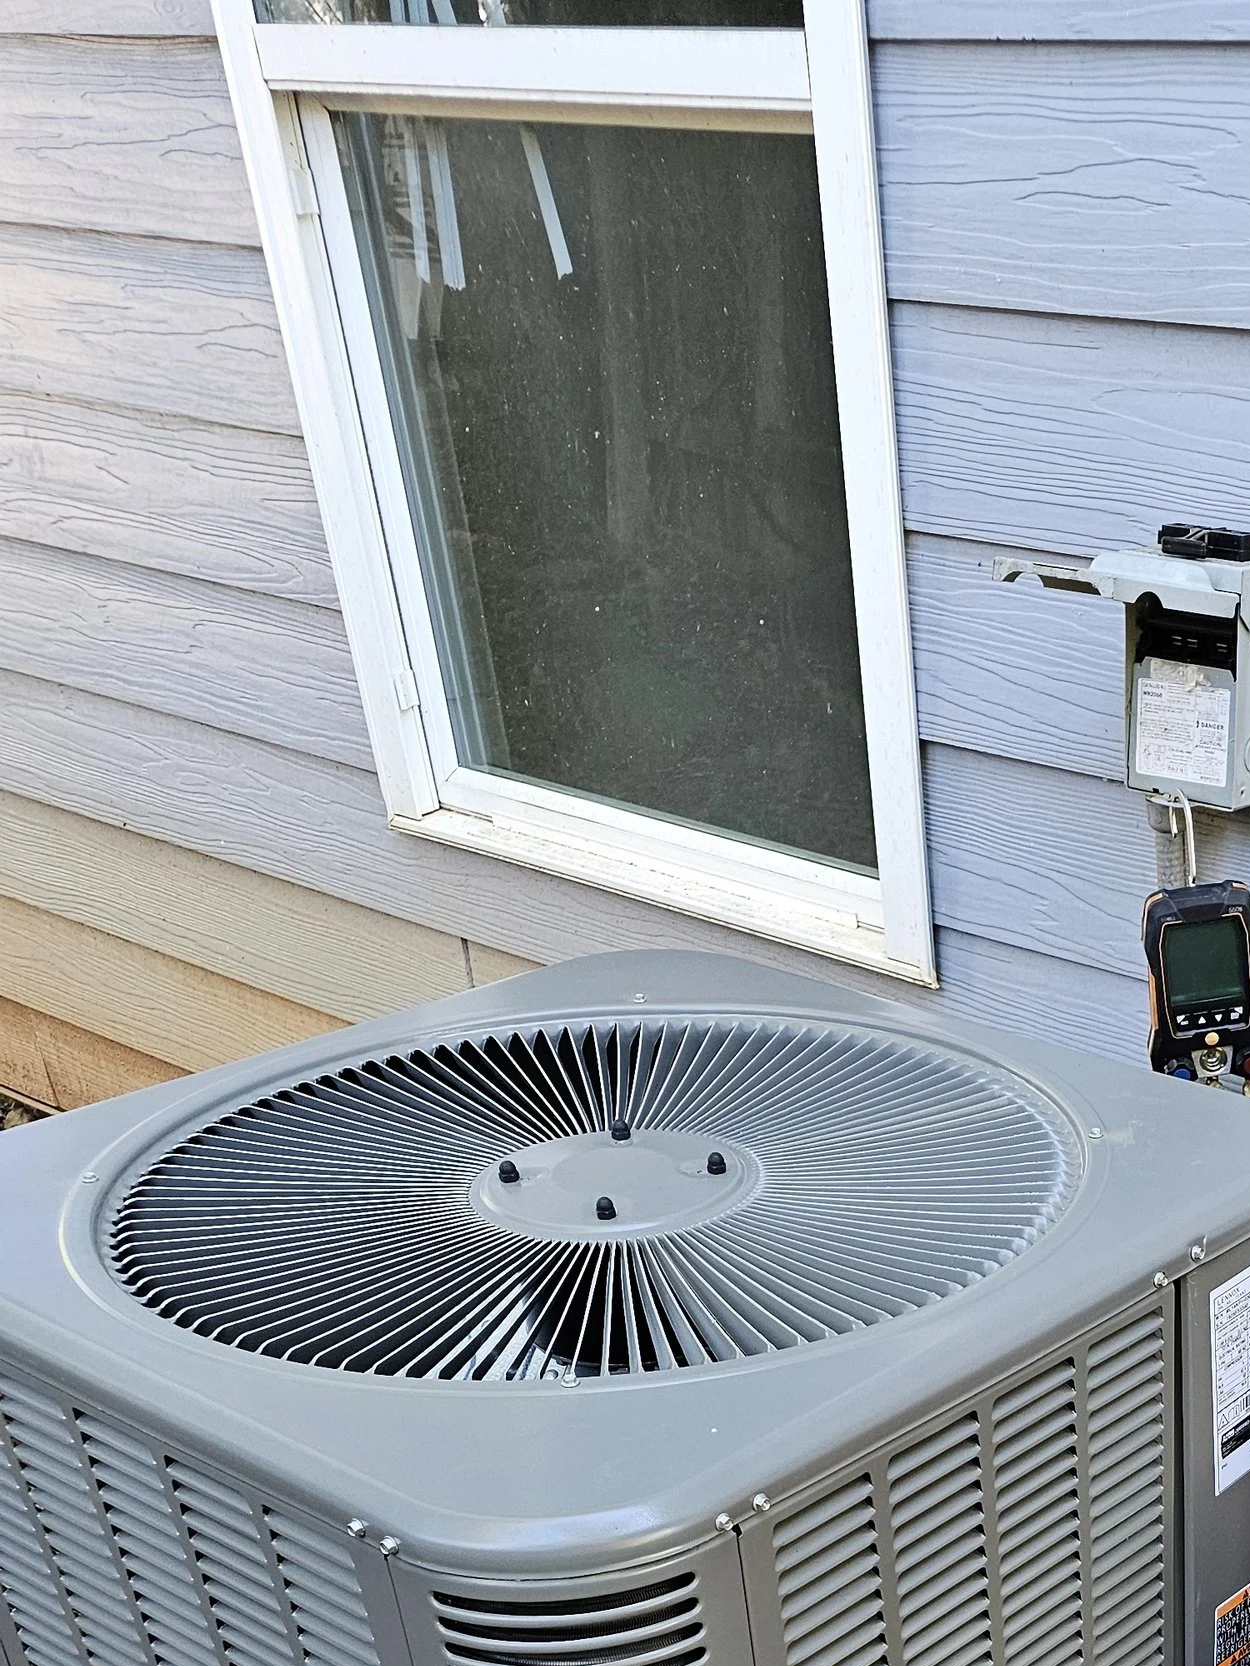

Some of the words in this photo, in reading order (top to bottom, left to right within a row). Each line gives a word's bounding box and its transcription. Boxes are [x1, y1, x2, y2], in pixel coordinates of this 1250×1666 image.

[1201, 722, 1224, 731] DANGER
[1217, 1611, 1233, 1627] RISK
[1235, 1600, 1245, 1615] OF
[1216, 1624, 1236, 1646] WITH
